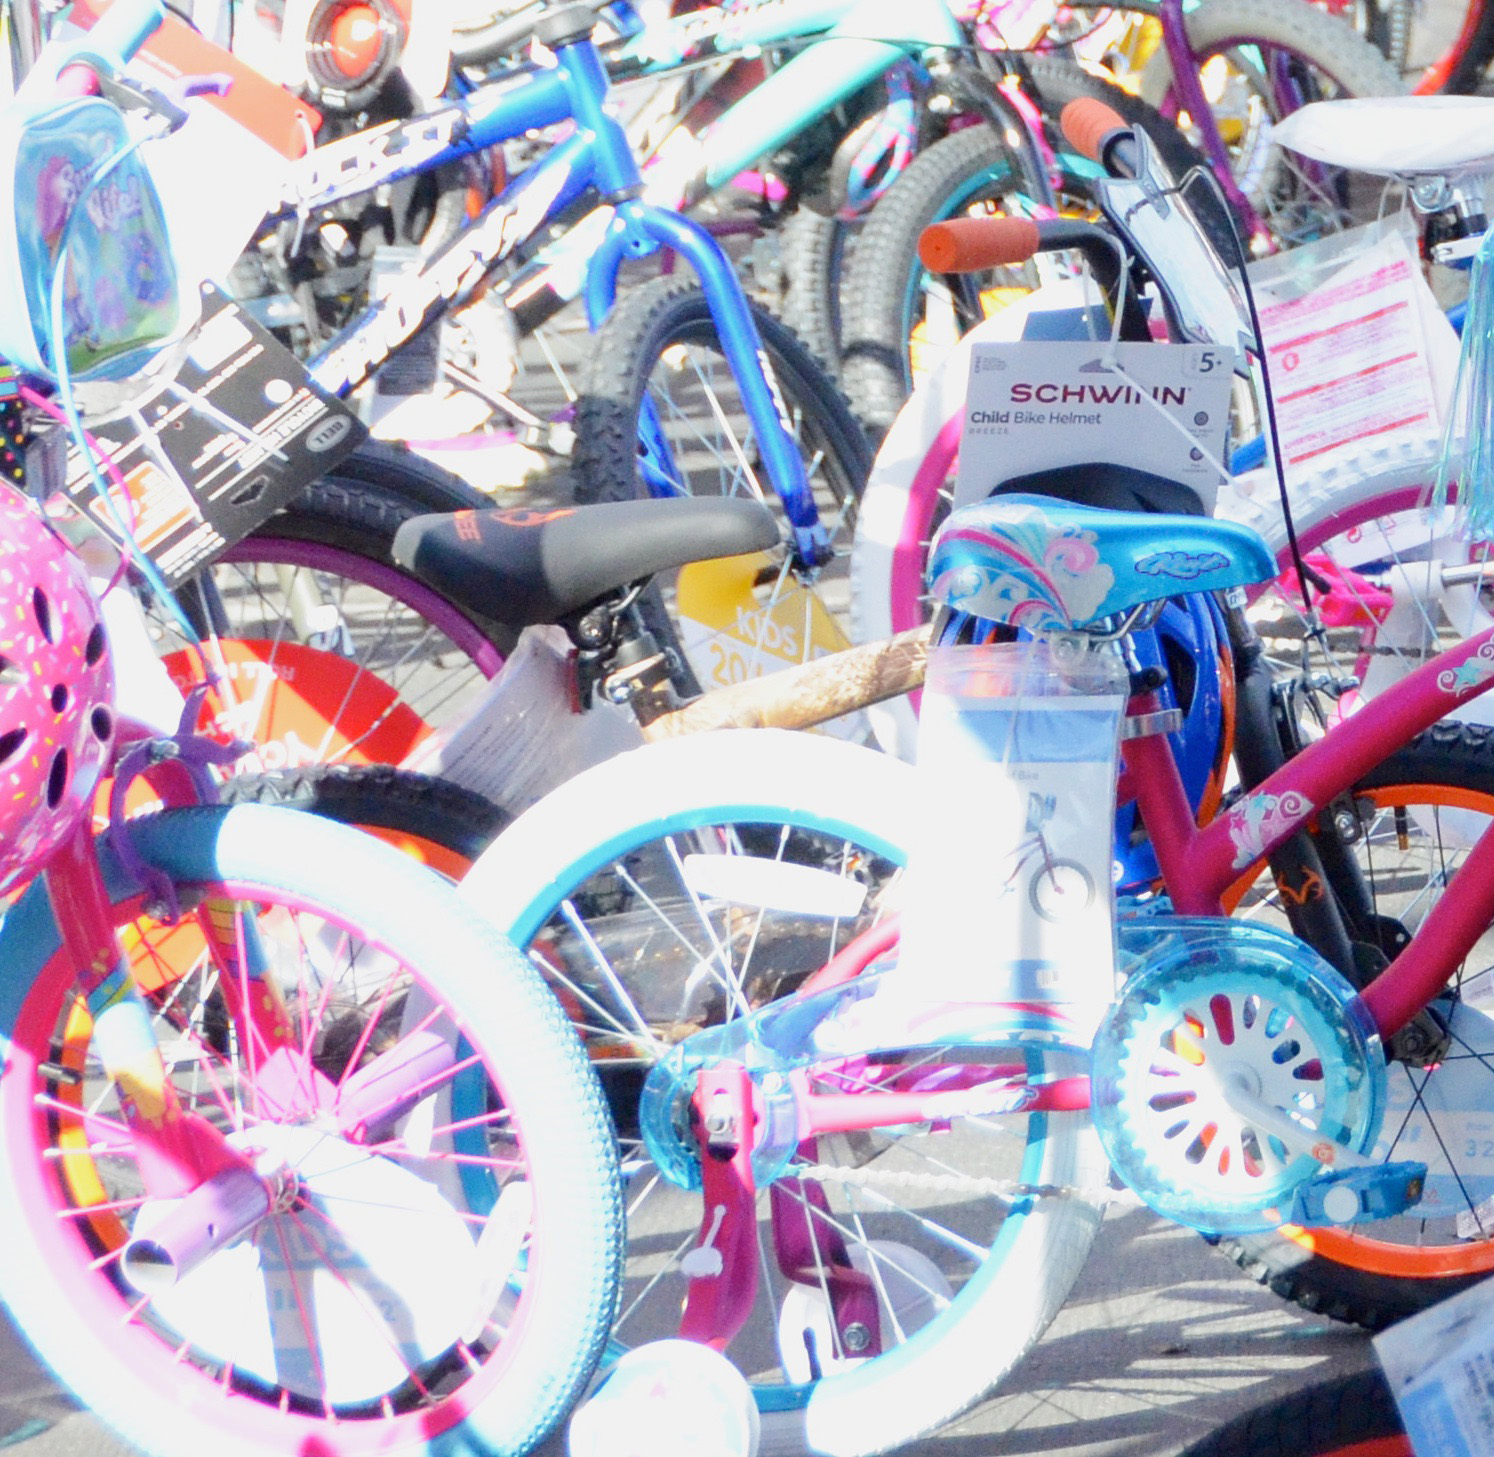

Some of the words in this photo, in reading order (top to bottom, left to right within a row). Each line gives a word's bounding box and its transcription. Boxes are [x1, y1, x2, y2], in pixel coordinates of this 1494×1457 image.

[1010, 383, 1187, 405] SCHWINN
[970, 411, 1010, 424] Child
[1013, 411, 1046, 424] Bike
[1049, 411, 1102, 425] Helmet
[735, 606, 799, 657] KIDS
